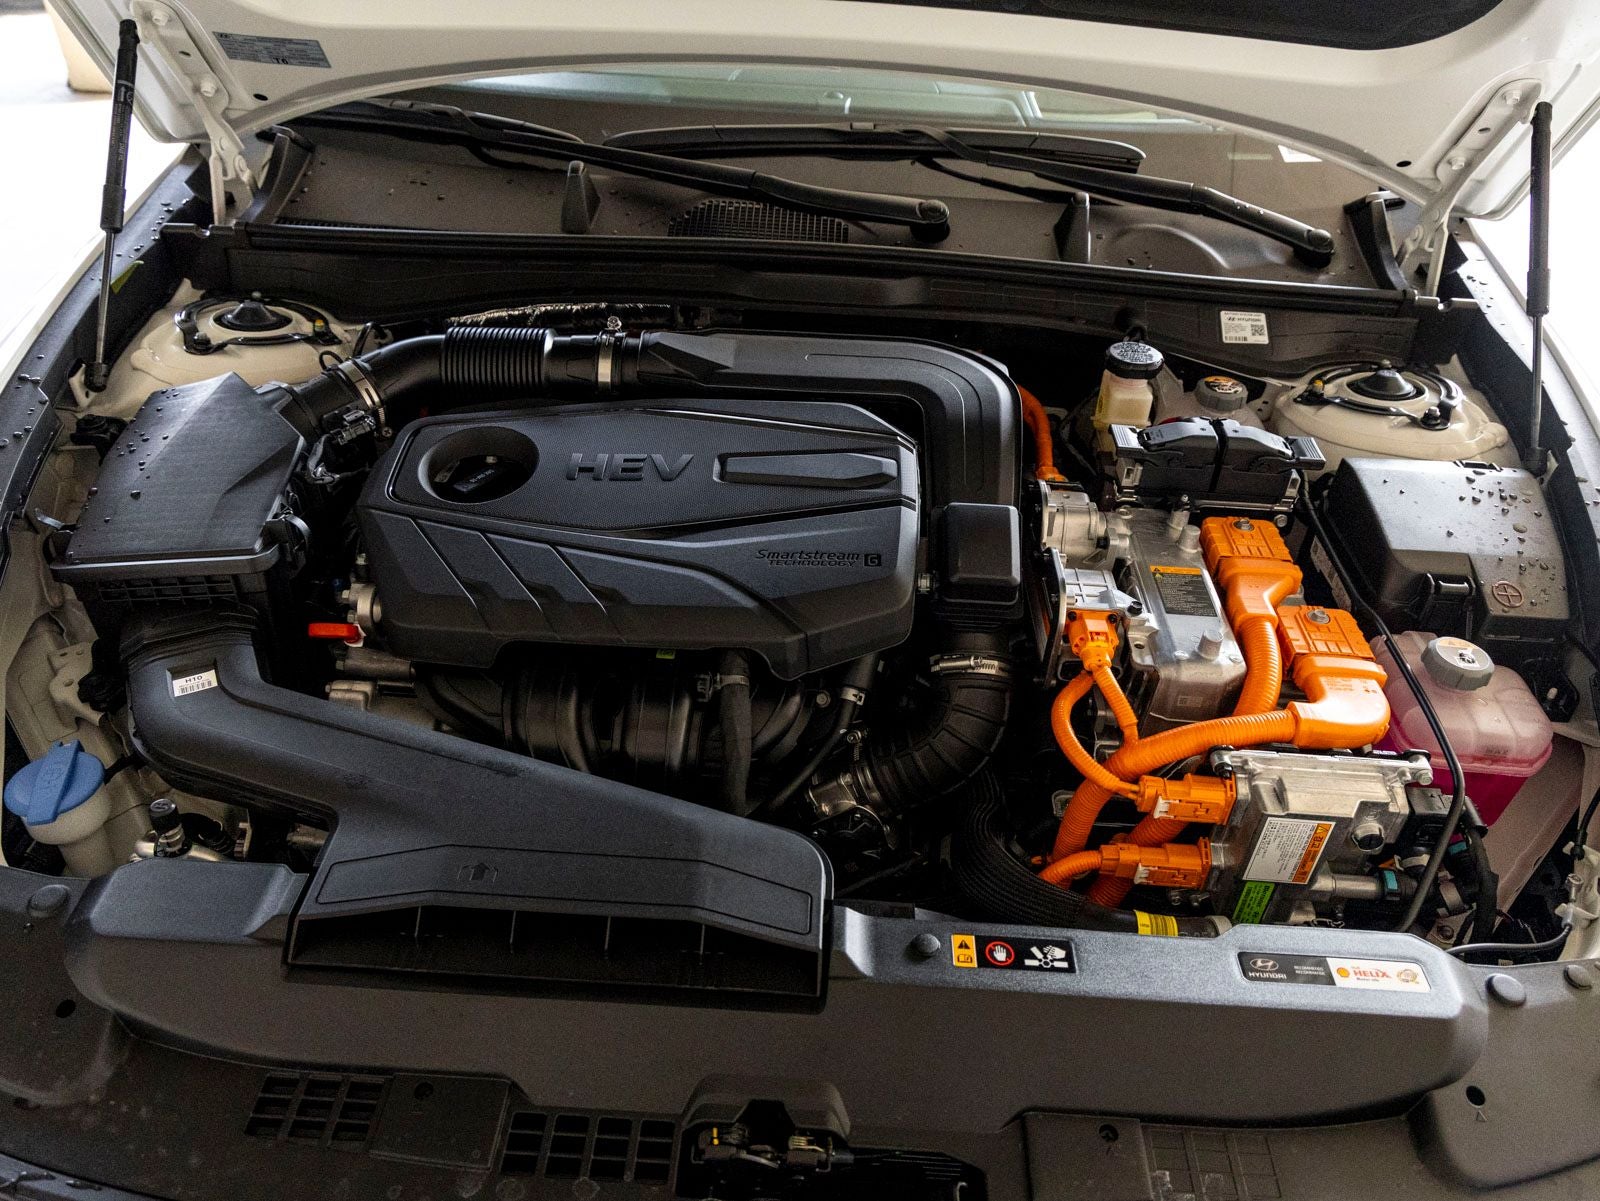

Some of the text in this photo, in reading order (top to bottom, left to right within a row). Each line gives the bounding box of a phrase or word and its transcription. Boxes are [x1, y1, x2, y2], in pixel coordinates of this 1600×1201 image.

[566, 453, 694, 481] HEV
[756, 549, 859, 561] Smartstream
[185, 675, 203, 683] H10
[1248, 971, 1287, 980] HYUNDAI
[1353, 969, 1391, 978] HELIX
